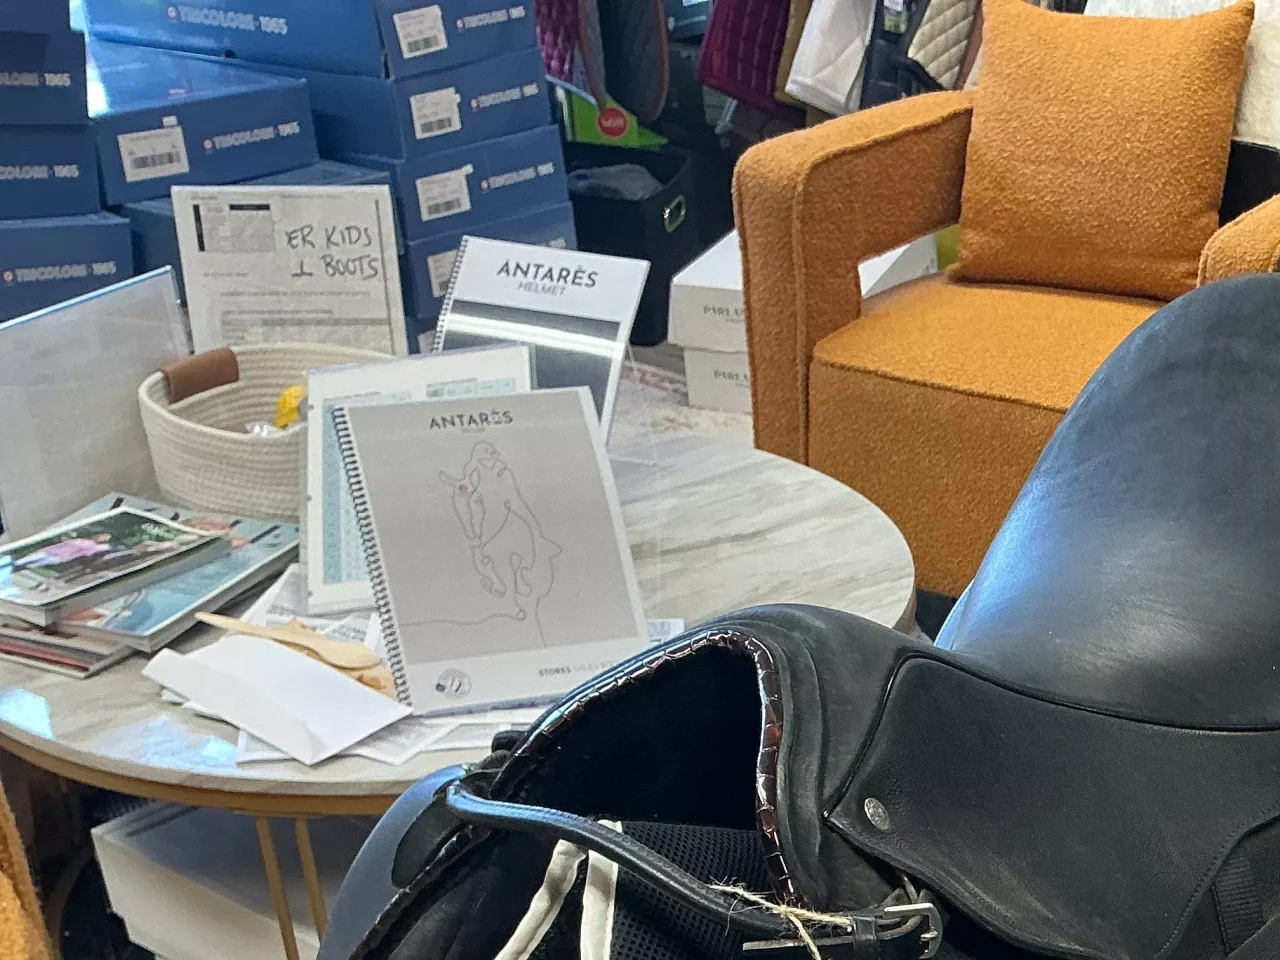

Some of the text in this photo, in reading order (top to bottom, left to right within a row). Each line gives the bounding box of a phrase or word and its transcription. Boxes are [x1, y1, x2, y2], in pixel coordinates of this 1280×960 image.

[324, 225, 373, 250] KIDS
[321, 254, 379, 280] BOOTS
[497, 259, 599, 288] ANTARÈS
[517, 281, 567, 296] HELMET
